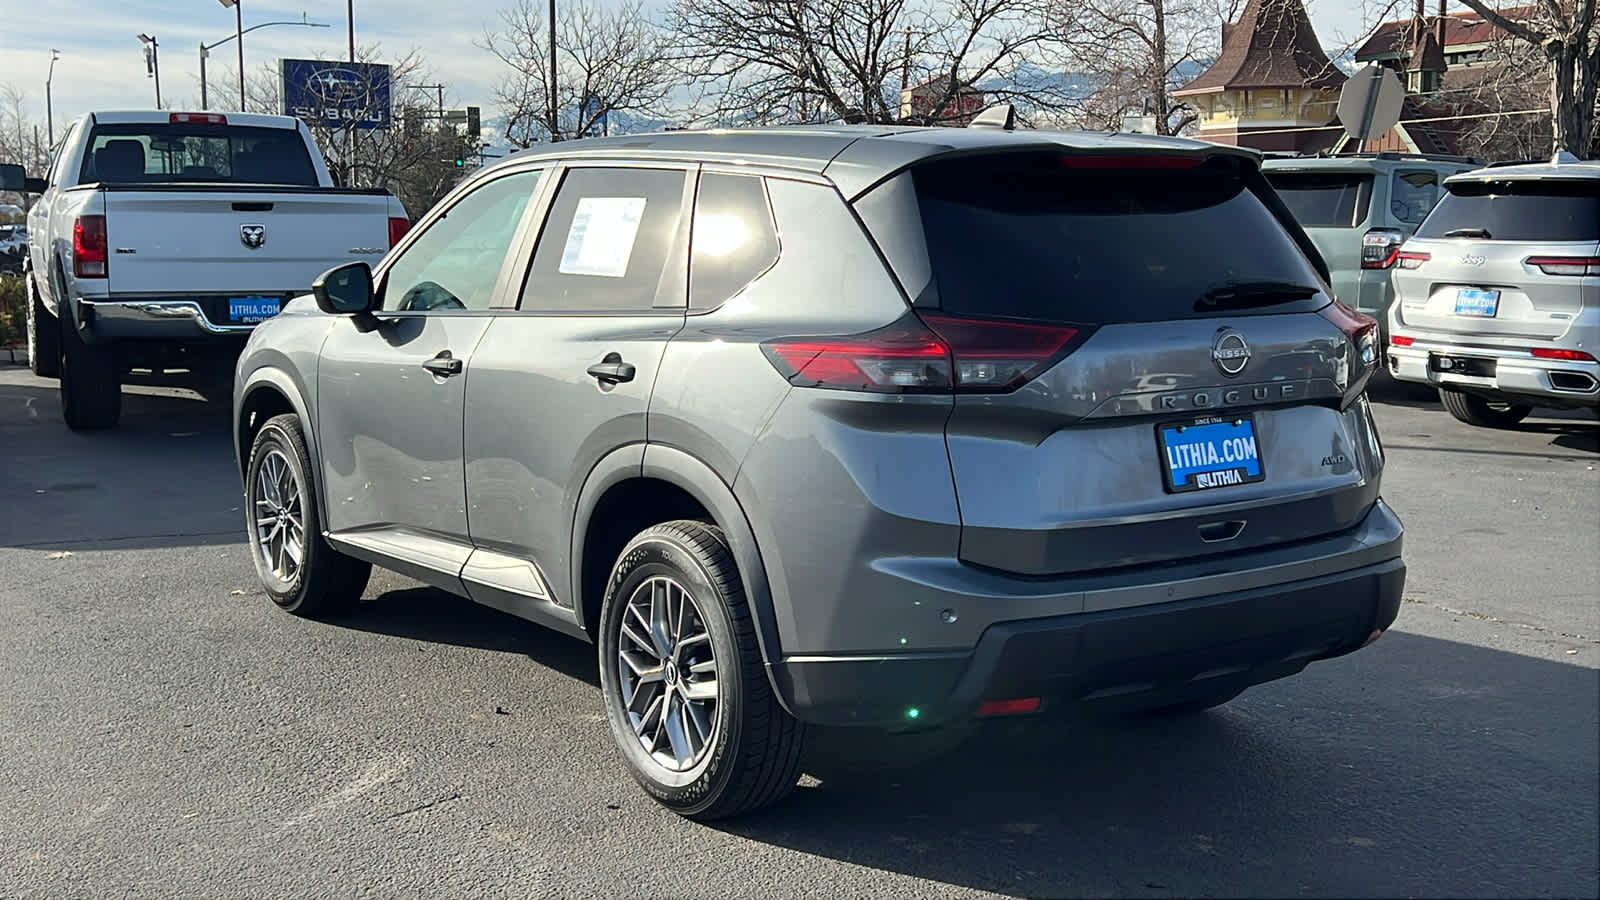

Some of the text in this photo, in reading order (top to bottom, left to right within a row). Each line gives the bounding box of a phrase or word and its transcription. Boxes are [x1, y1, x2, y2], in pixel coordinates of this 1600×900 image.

[294, 106, 383, 122] SUBARU
[230, 304, 280, 314] LITHIA.COM
[1212, 348, 1251, 359] NISSAN
[1160, 385, 1294, 409] ROGUE
[1166, 436, 1258, 470] LITHIA.COM
[1320, 455, 1344, 467] AWD
[1207, 469, 1242, 487] LITHIA
